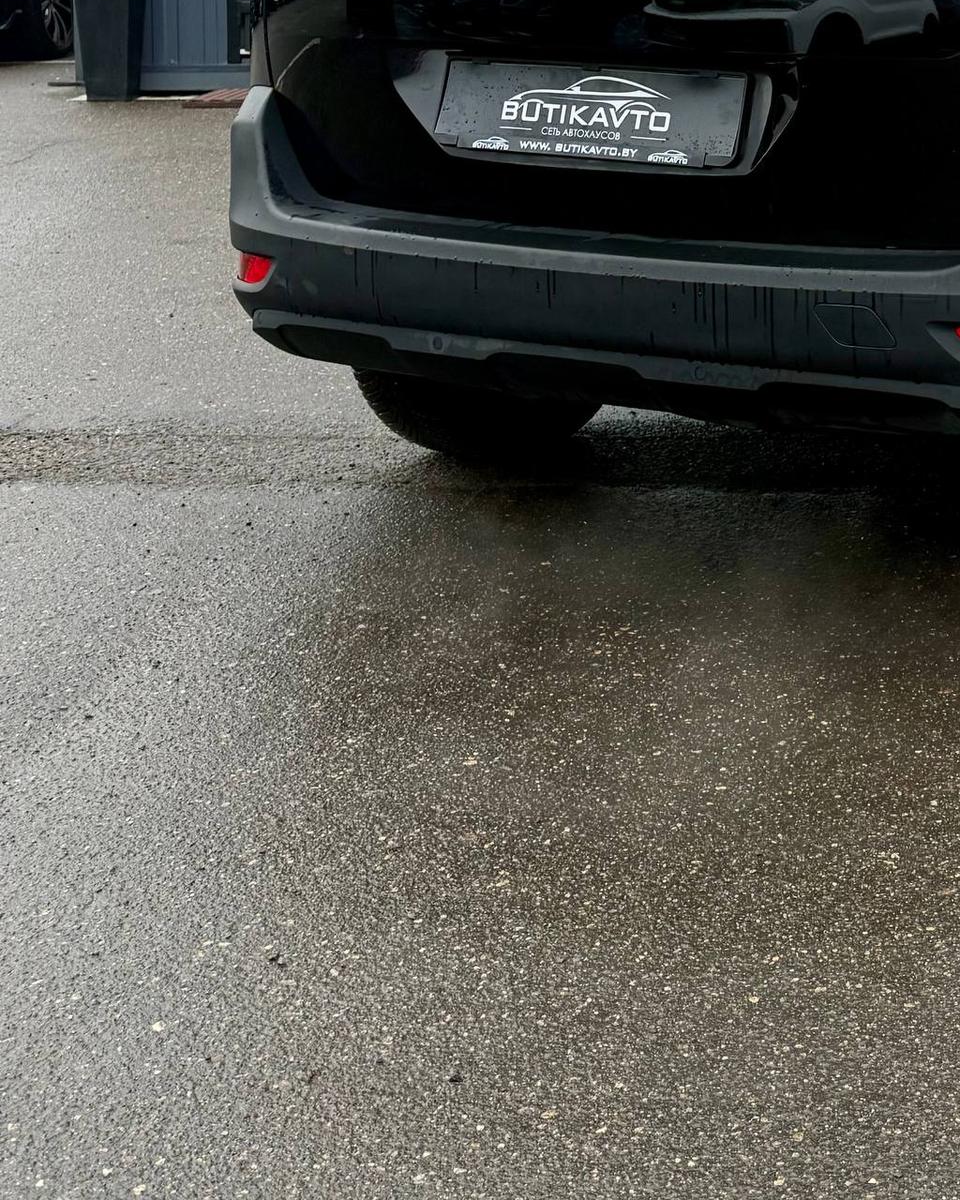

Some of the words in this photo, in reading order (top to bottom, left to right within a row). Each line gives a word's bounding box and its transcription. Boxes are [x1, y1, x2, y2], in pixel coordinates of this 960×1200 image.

[500, 100, 671, 132] BUTIKAVTO
[541, 125, 561, 137] СЕТЬ
[563, 128, 621, 142] АВТОХАУСОВ
[519, 140, 551, 151] WWW.
[555, 143, 638, 158] BUTIKAVTO.BY
